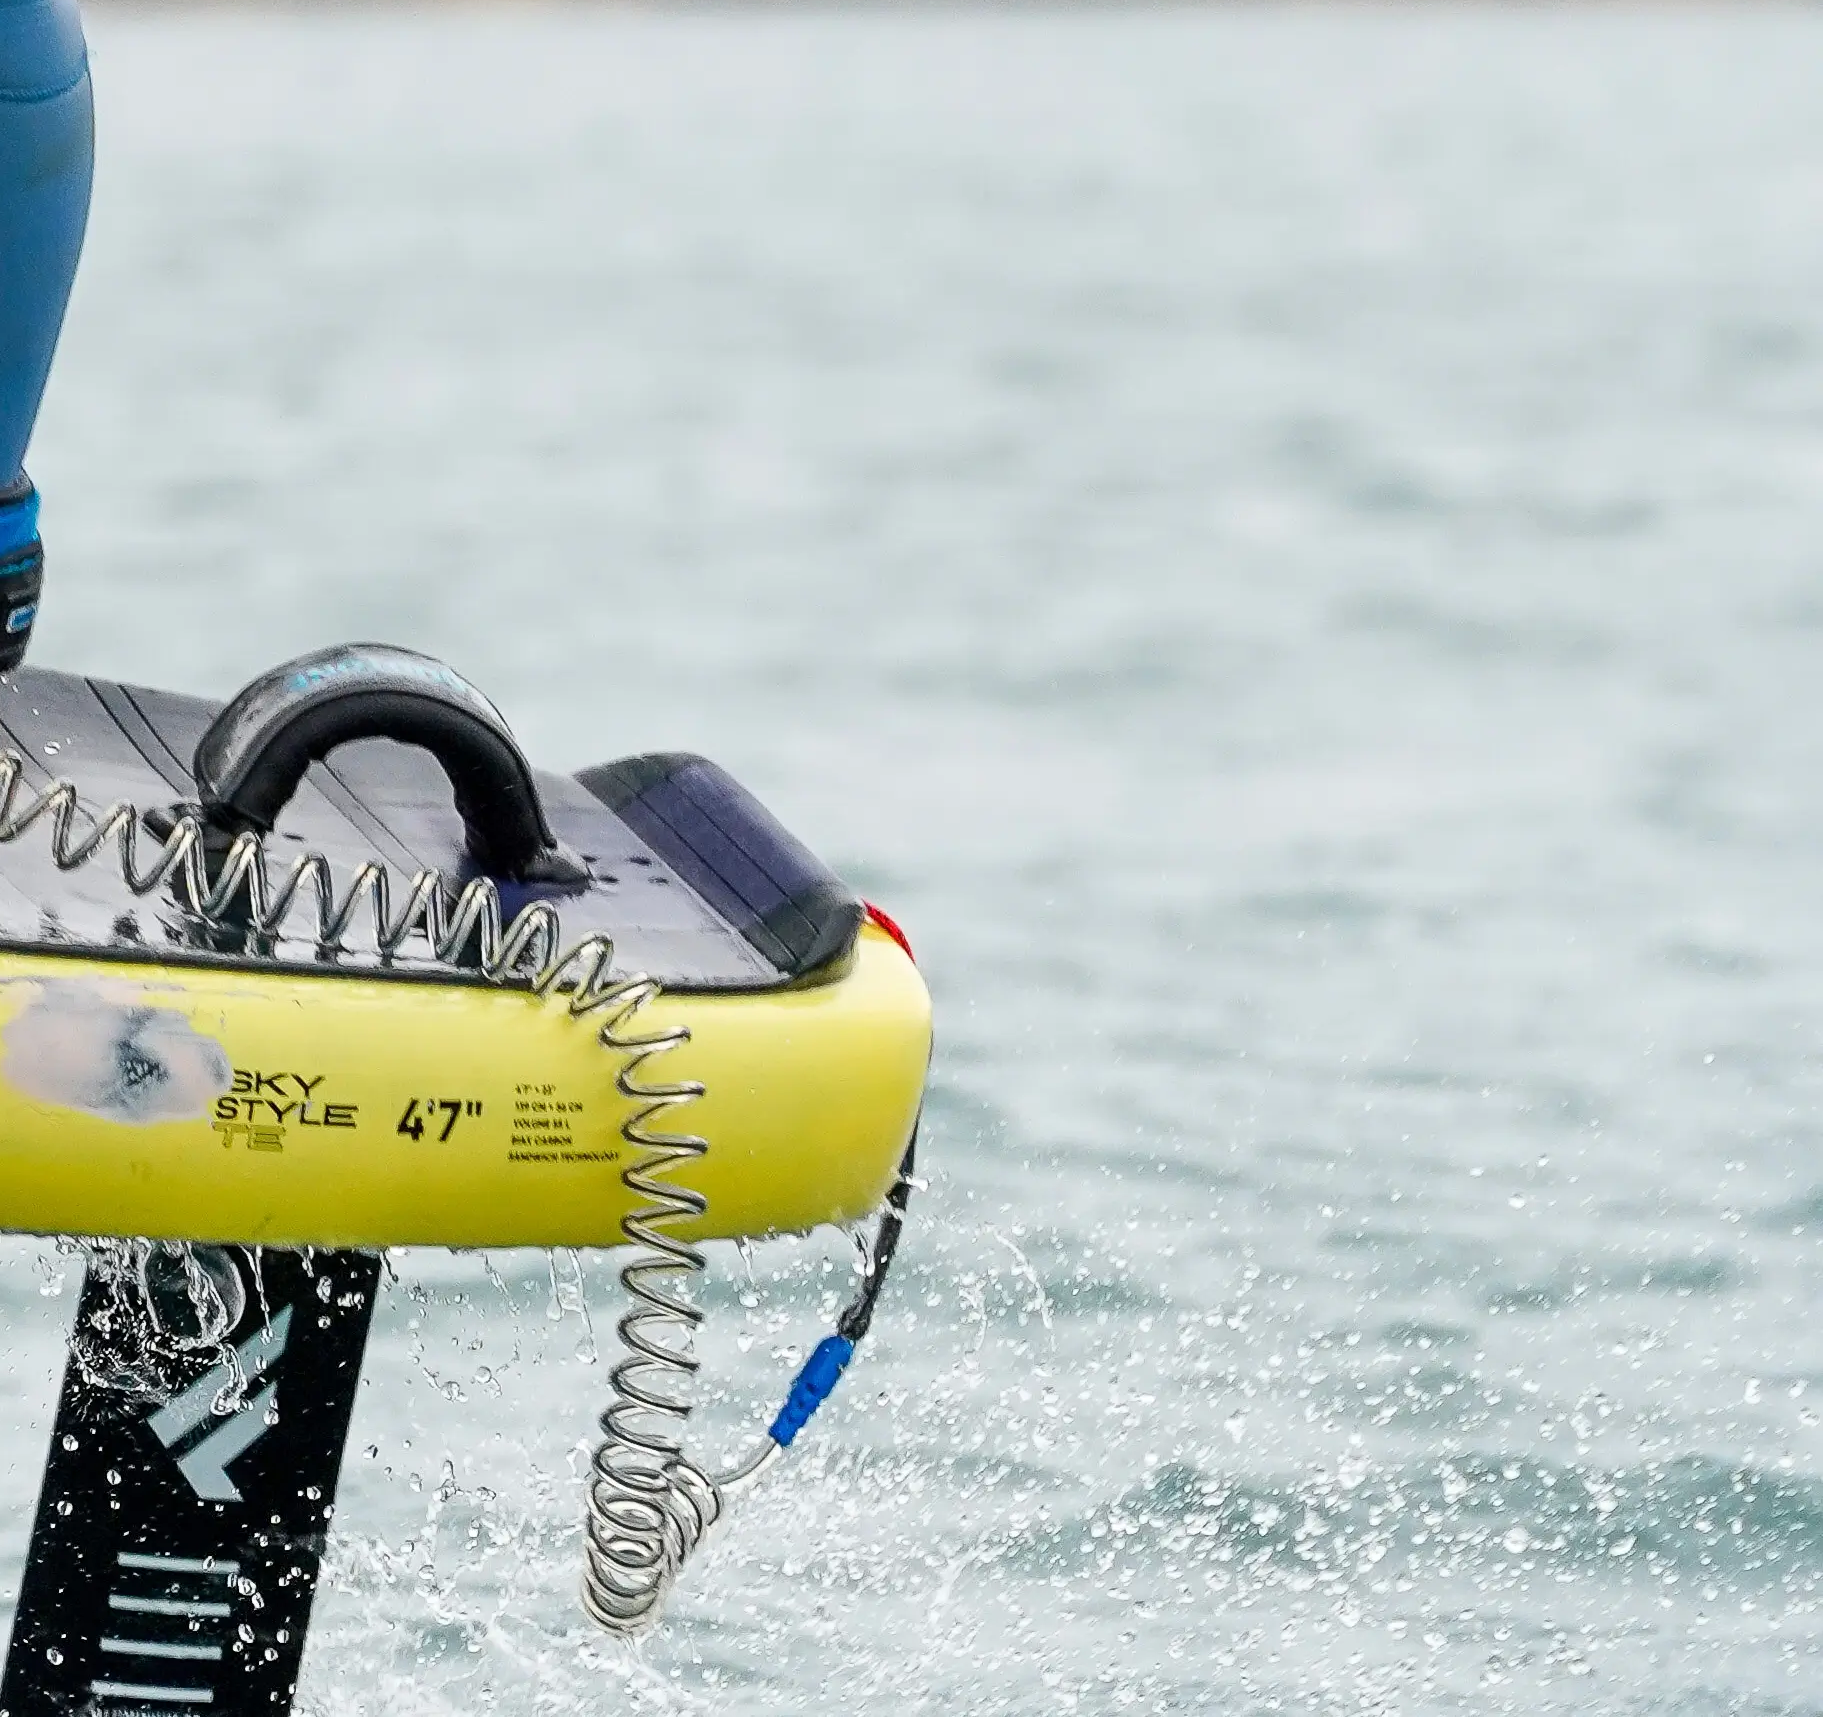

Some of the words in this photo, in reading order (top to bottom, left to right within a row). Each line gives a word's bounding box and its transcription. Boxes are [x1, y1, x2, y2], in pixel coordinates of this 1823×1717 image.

[231, 1068, 325, 1099] SKY
[215, 1096, 359, 1129] STYLE
[396, 1097, 484, 1143] 4'7"
